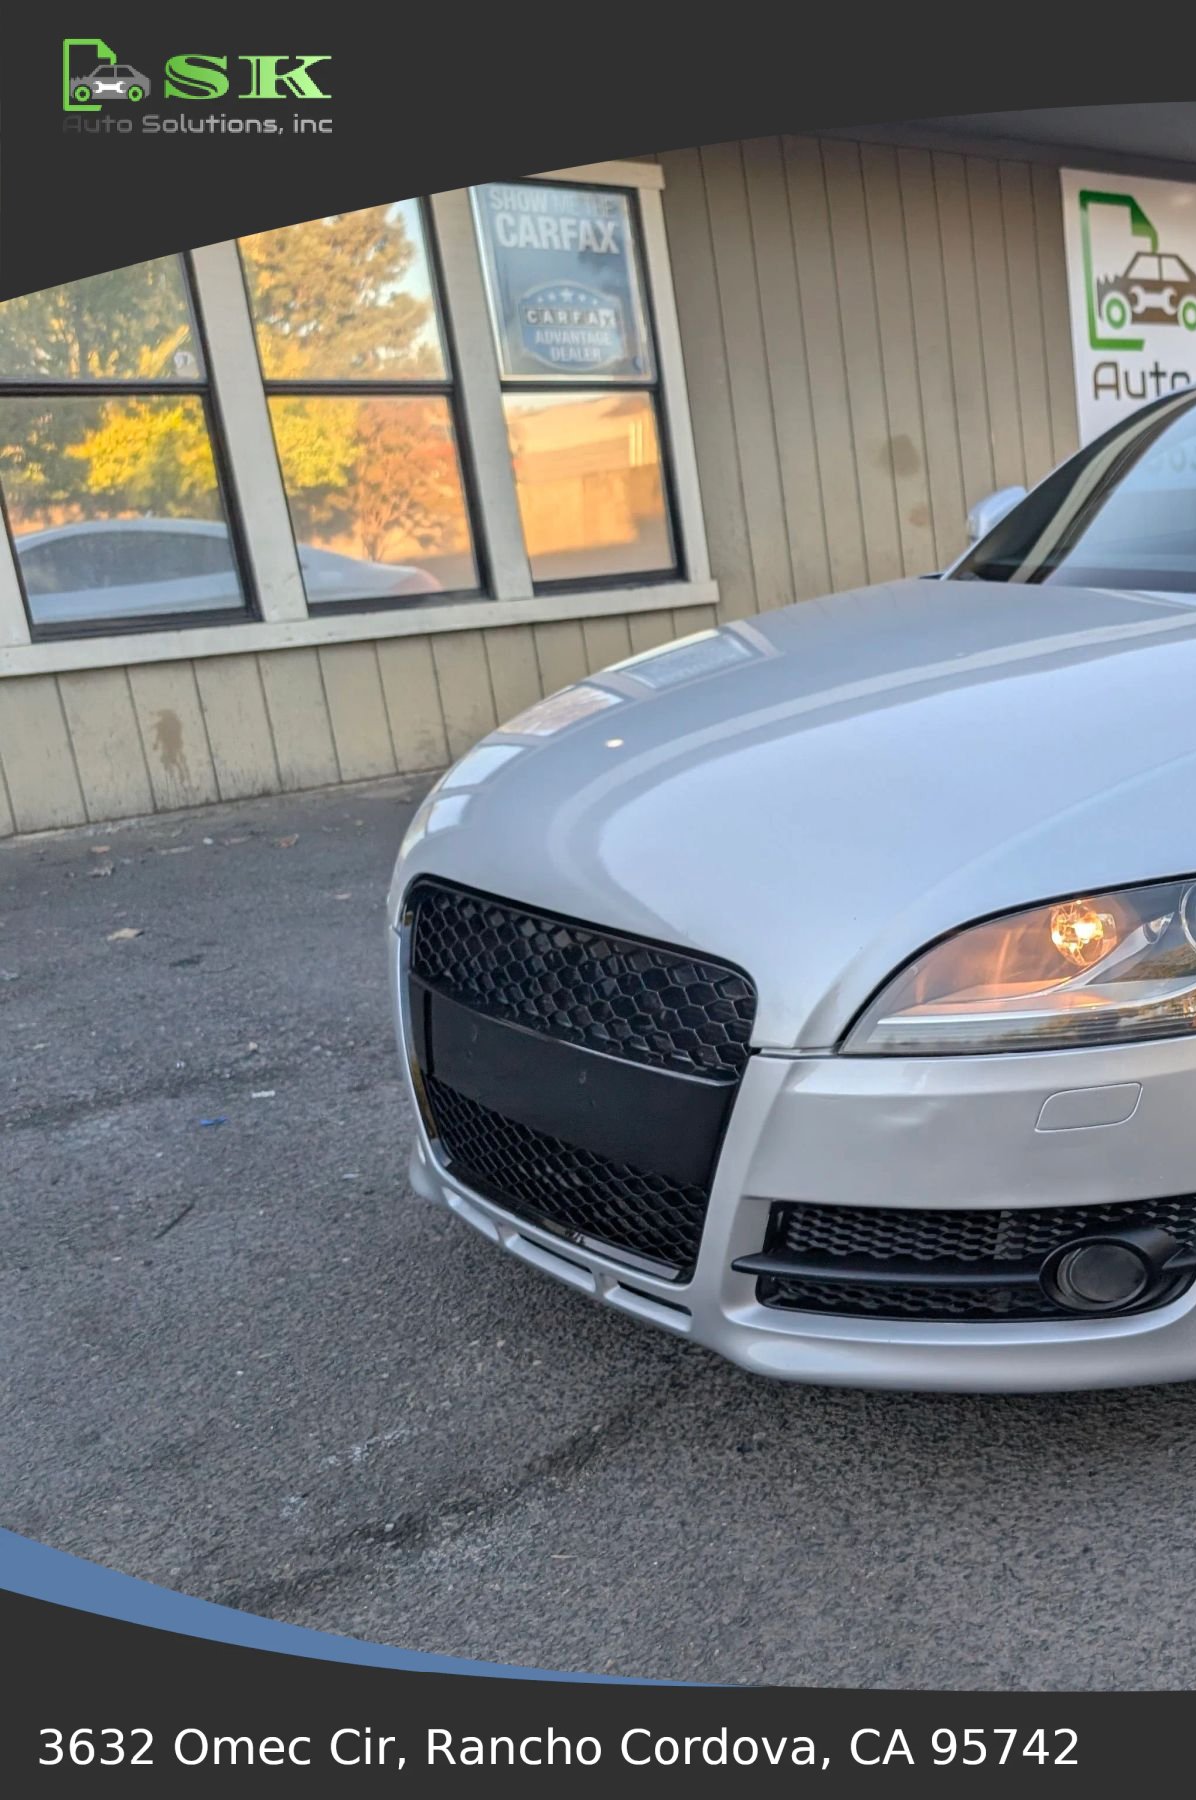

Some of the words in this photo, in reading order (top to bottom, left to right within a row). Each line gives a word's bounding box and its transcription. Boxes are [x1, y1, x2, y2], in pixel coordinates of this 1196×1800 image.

[490, 189, 549, 213] SHOW
[495, 214, 620, 254] CARFAX
[526, 309, 616, 328] CARFAX
[535, 330, 612, 346] ADVANTAGE
[551, 347, 602, 363] DEALER
